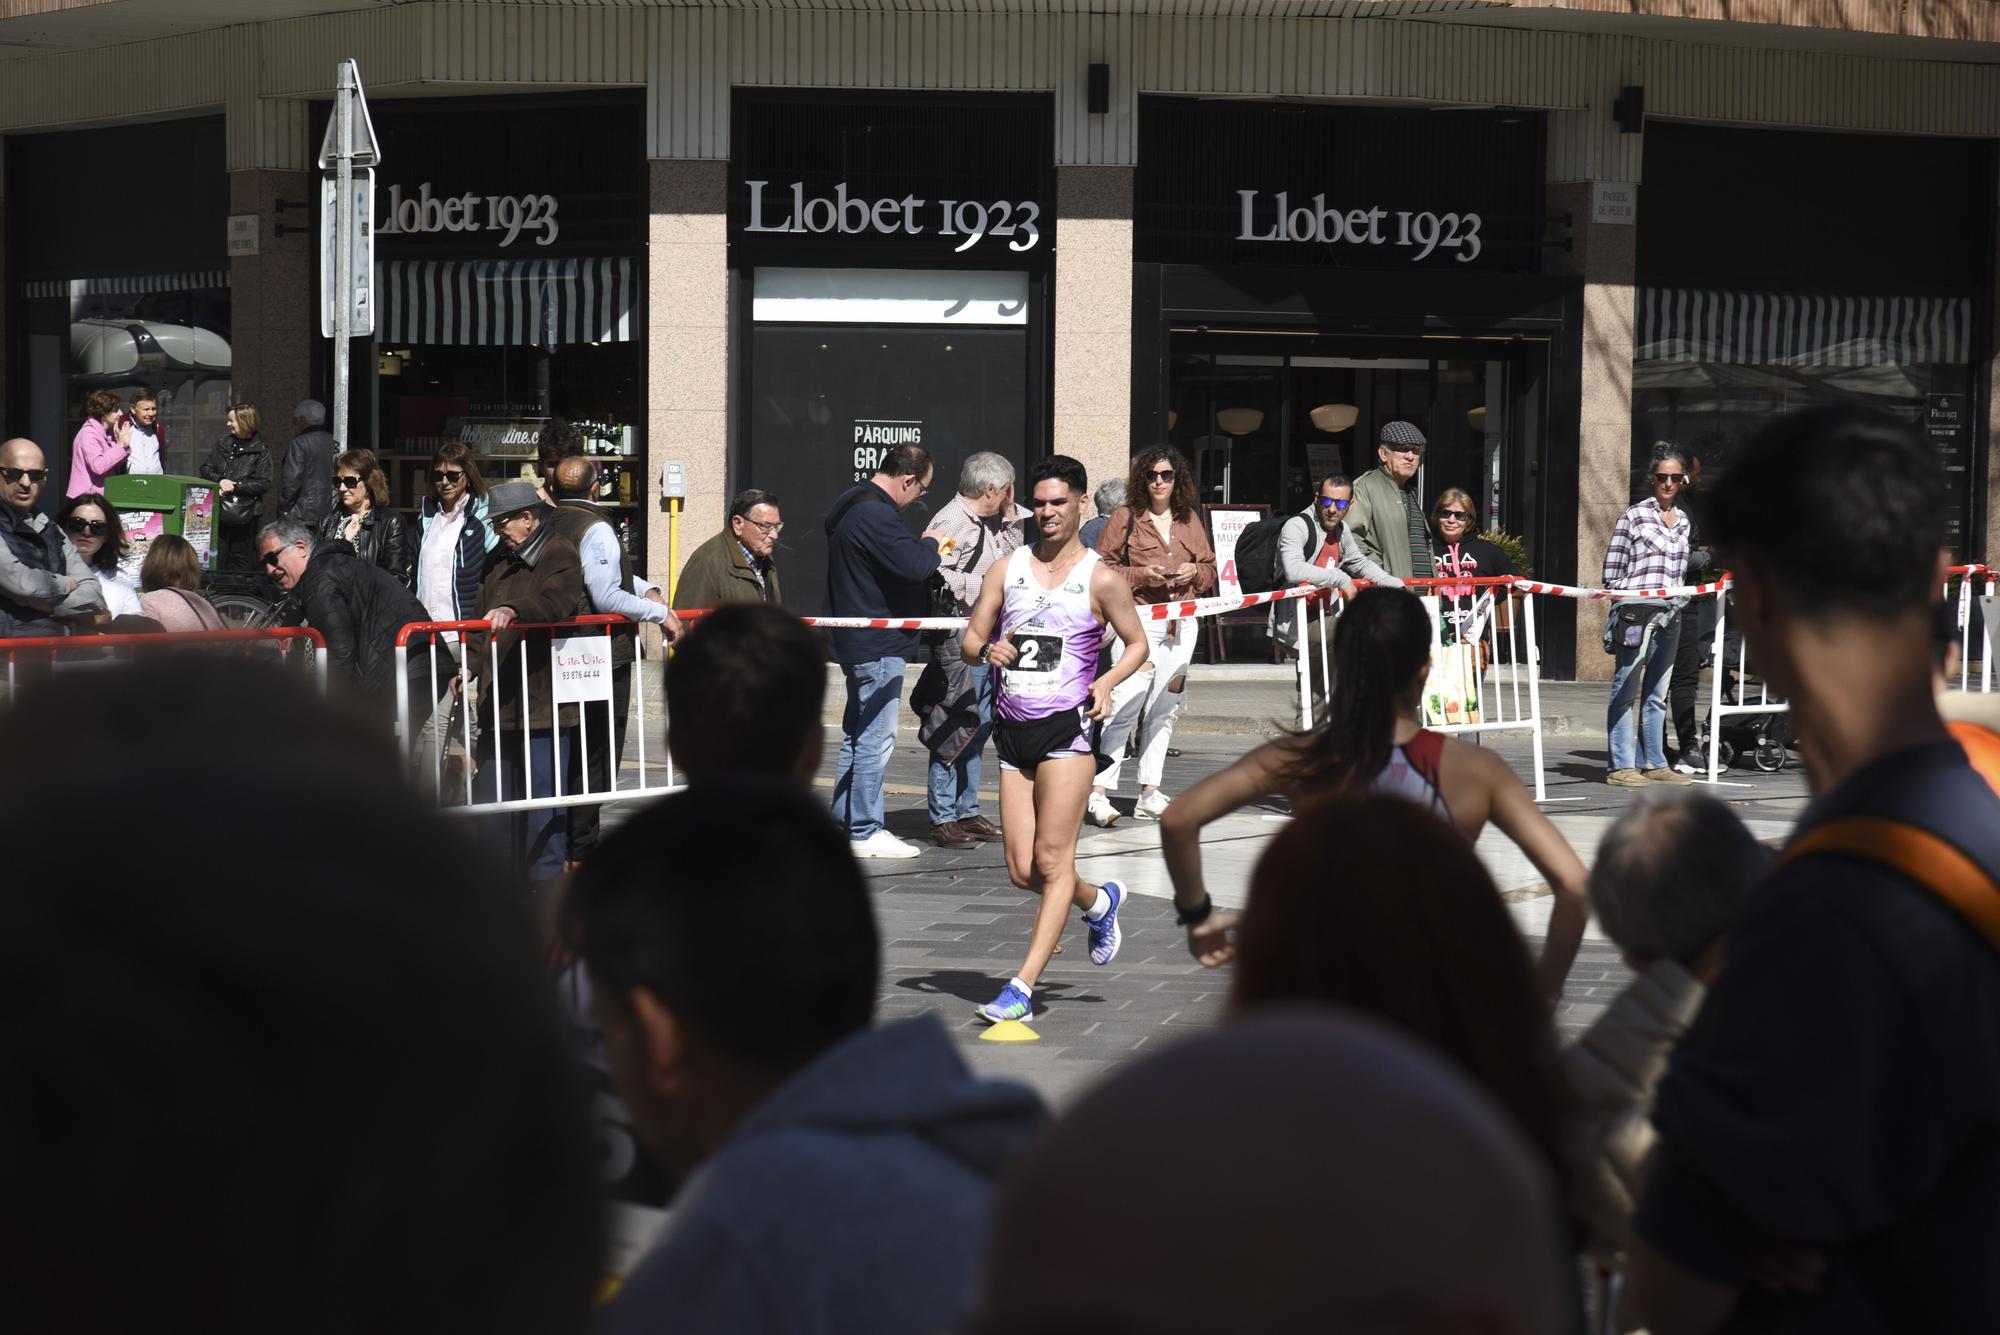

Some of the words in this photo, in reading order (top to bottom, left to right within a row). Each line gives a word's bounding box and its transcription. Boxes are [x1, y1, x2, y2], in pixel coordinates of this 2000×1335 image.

[486, 194, 559, 247] 1923
[744, 180, 925, 235] Llobet
[938, 200, 1041, 253] 1923
[1235, 189, 1389, 244] Llobet
[1394, 211, 1482, 262] 1923
[460, 424, 540, 444] llobetonline.c
[854, 424, 921, 445] PÀRQUING
[854, 447, 888, 469] GRA
[1018, 639, 1040, 669] 2
[562, 671, 570, 680] 93
[584, 670, 591, 678] 44
